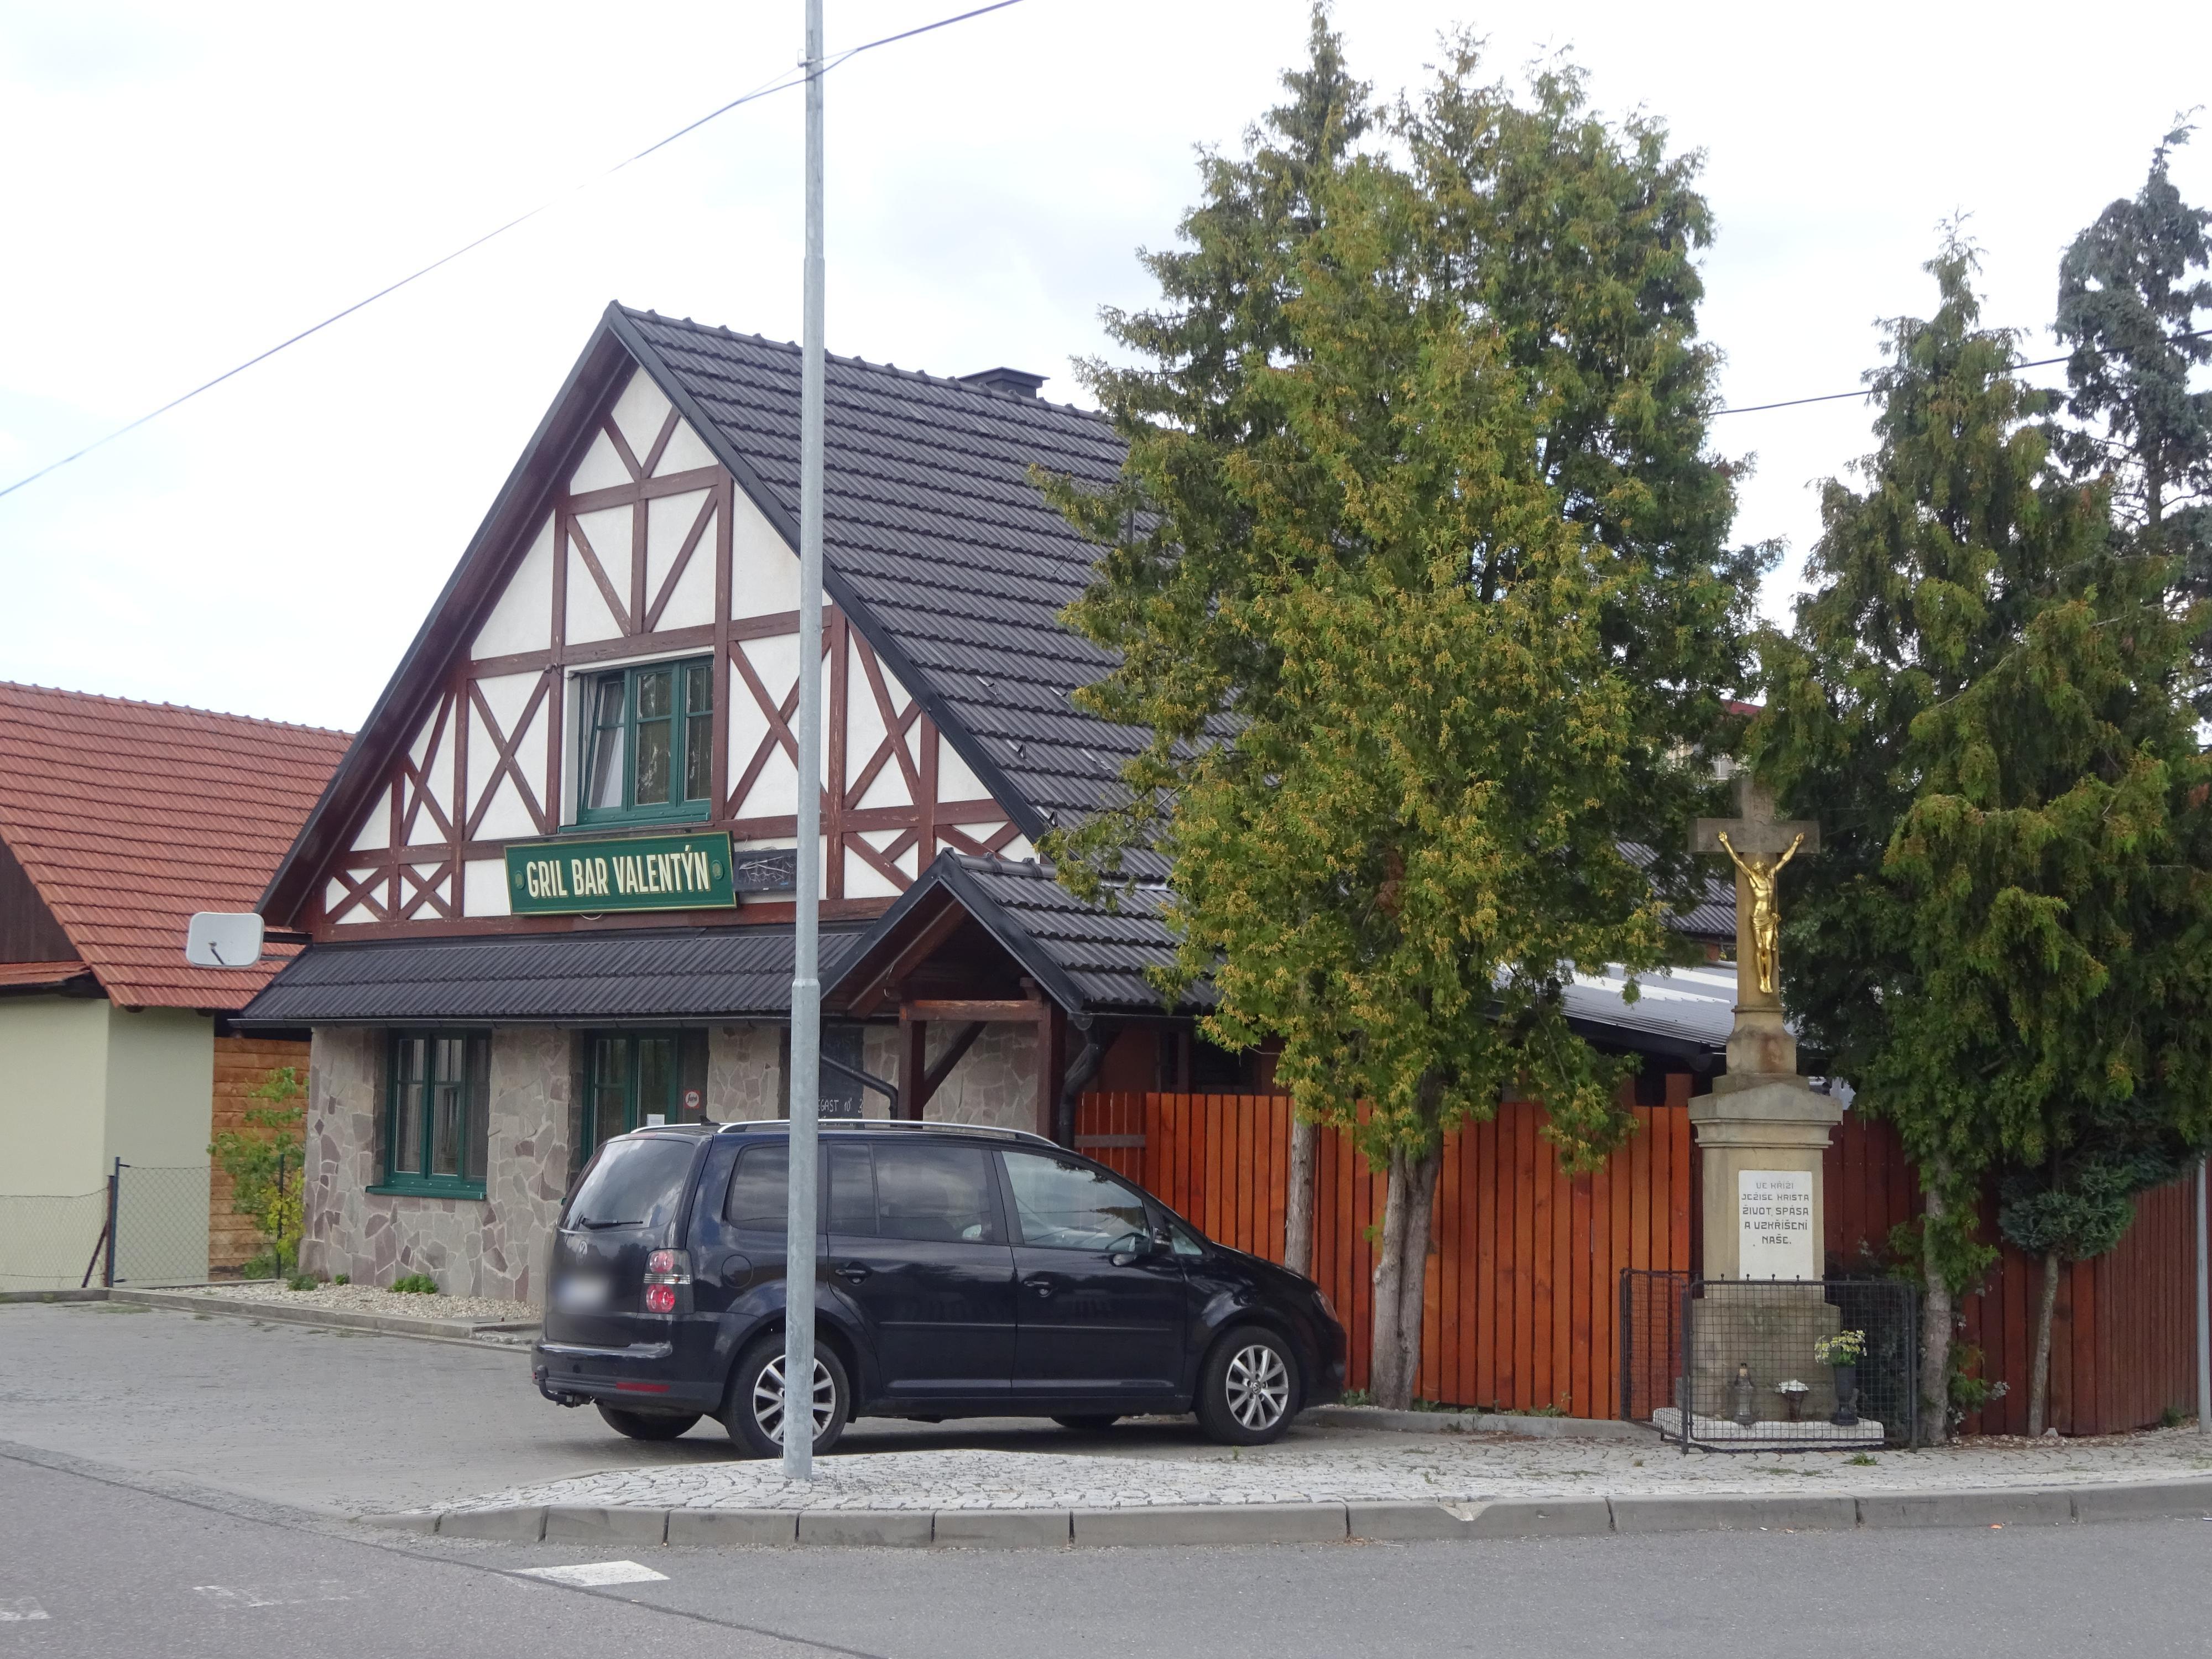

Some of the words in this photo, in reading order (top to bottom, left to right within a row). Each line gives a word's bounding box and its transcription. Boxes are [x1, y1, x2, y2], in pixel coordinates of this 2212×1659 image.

[526, 860, 567, 899] GRIL
[571, 857, 609, 897] BAR
[613, 845, 710, 894] VALENTÝN
[1776, 1205, 1809, 1215] SPÁSA
[1744, 1221, 1751, 1229] A
[1762, 1233, 1792, 1244] NAŠE.
